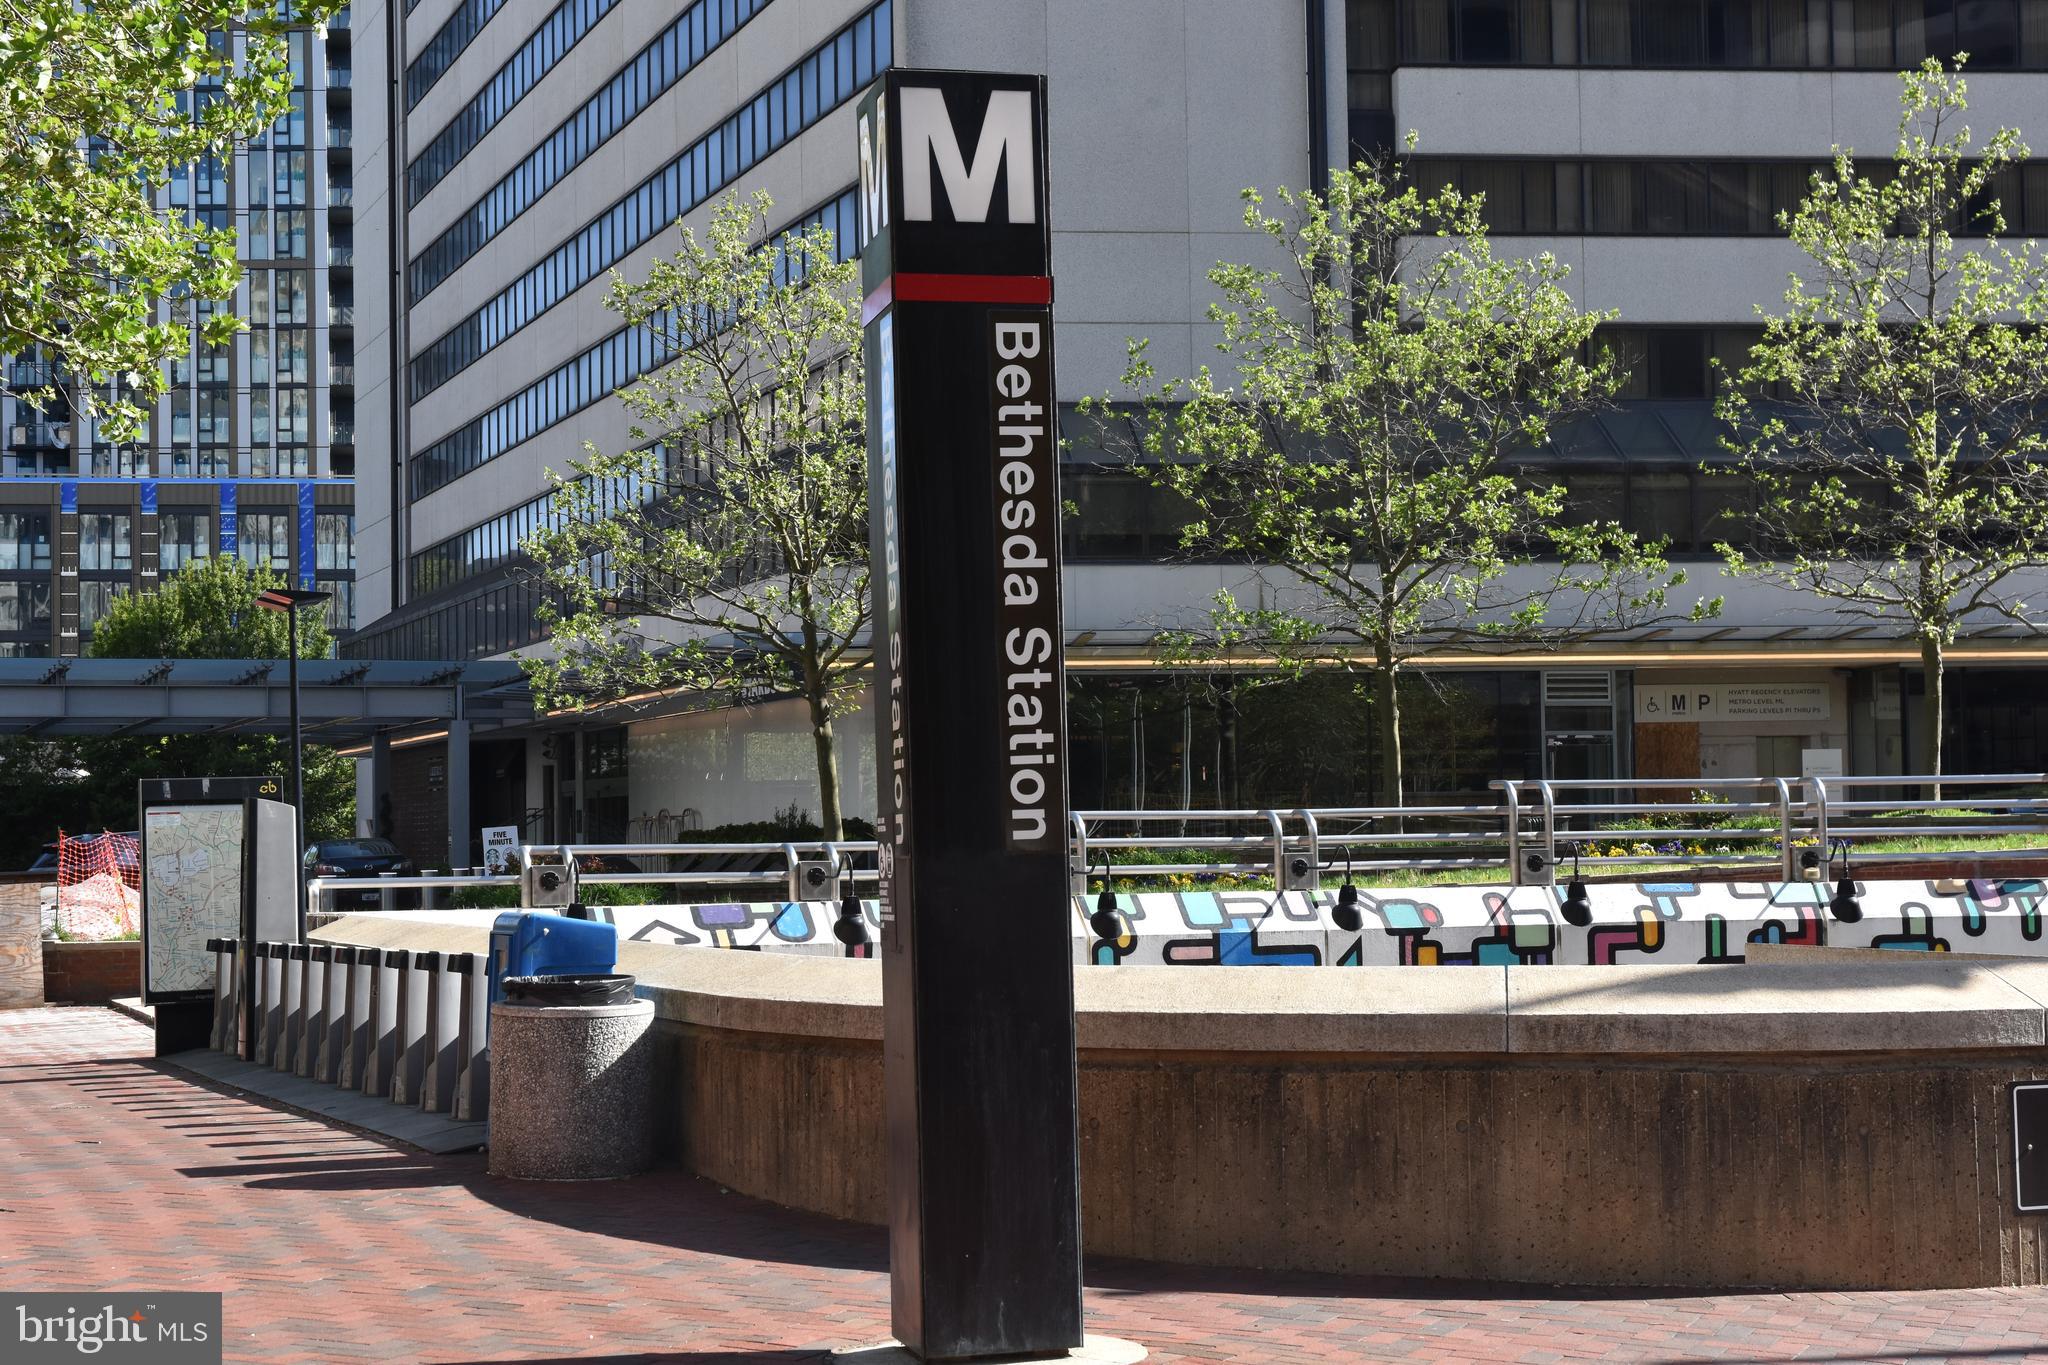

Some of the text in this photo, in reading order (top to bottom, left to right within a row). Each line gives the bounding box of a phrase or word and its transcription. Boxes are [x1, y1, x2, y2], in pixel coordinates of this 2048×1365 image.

[859, 90, 889, 249] M
[899, 86, 1036, 224] M
[995, 322, 1055, 840] Bethesda Station
[889, 631, 904, 845] Station
[1671, 694, 1686, 710] M
[1698, 694, 1711, 710] P
[488, 838, 513, 846] MINUTE
